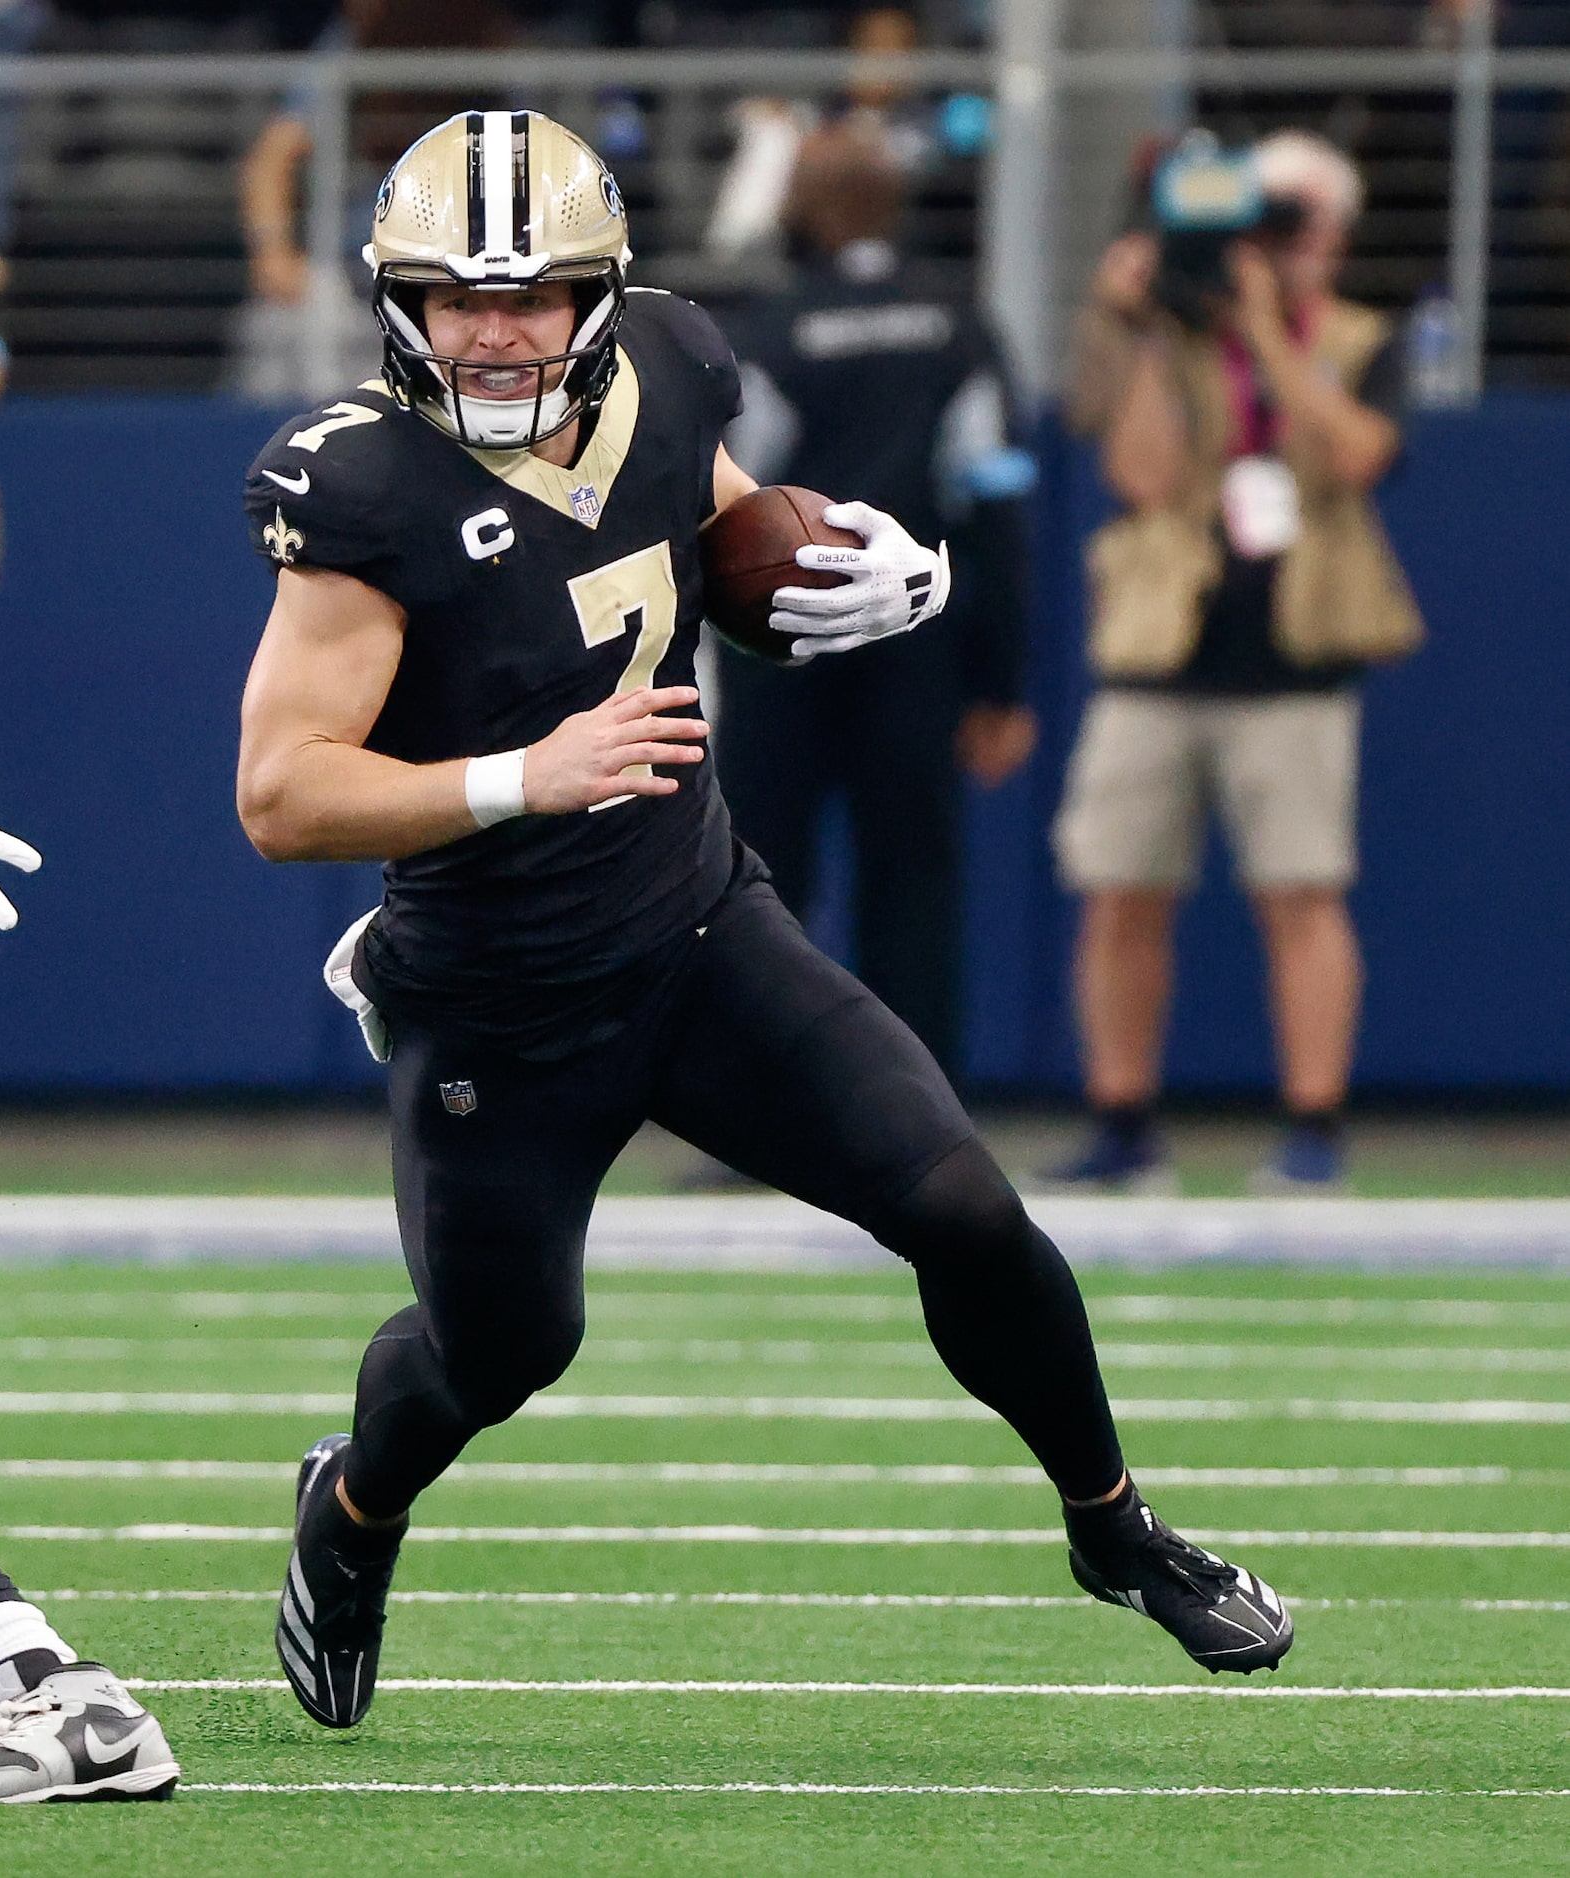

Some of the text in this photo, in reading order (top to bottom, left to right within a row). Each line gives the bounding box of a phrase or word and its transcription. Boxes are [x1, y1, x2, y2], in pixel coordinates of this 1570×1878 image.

[287, 402, 384, 453] 7
[461, 507, 515, 560] C
[577, 499, 598, 516] NFL
[567, 540, 678, 813] 7
